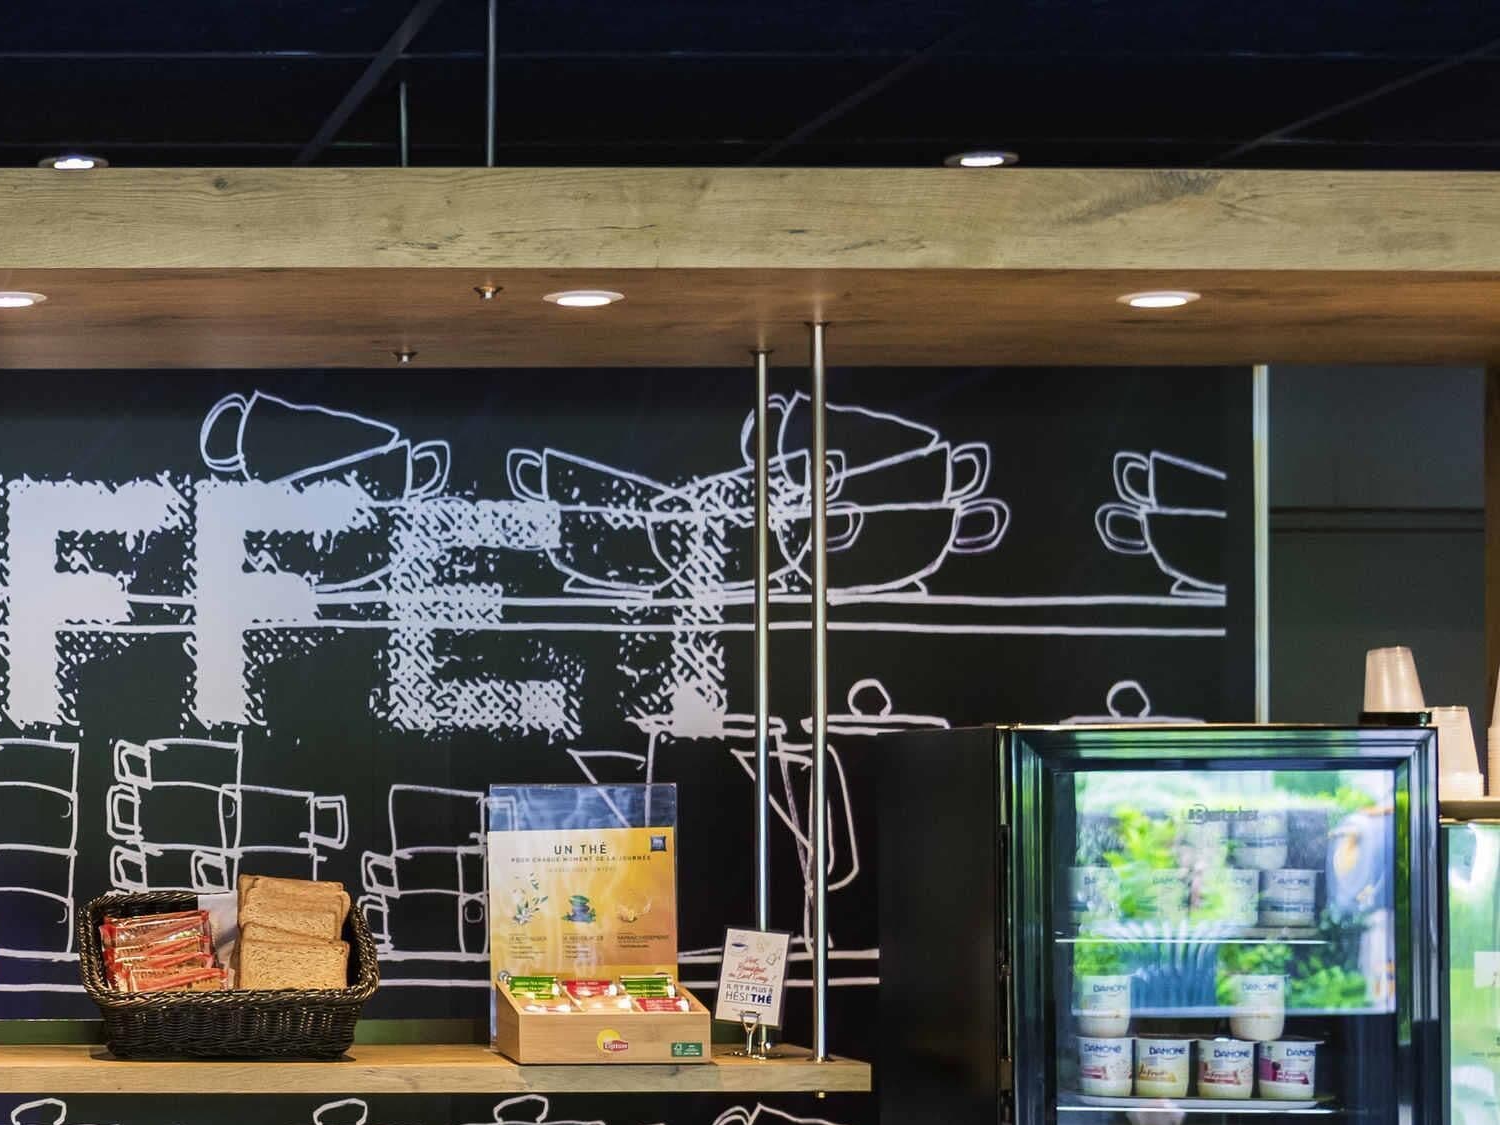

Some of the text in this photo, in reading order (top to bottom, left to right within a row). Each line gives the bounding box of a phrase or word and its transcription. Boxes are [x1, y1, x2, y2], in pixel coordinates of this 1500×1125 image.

[554, 844, 573, 855] UN
[1083, 1043, 1122, 1054] DANONE
[1148, 1046, 1187, 1056] DANONE
[1213, 1048, 1251, 1058] DANONE
